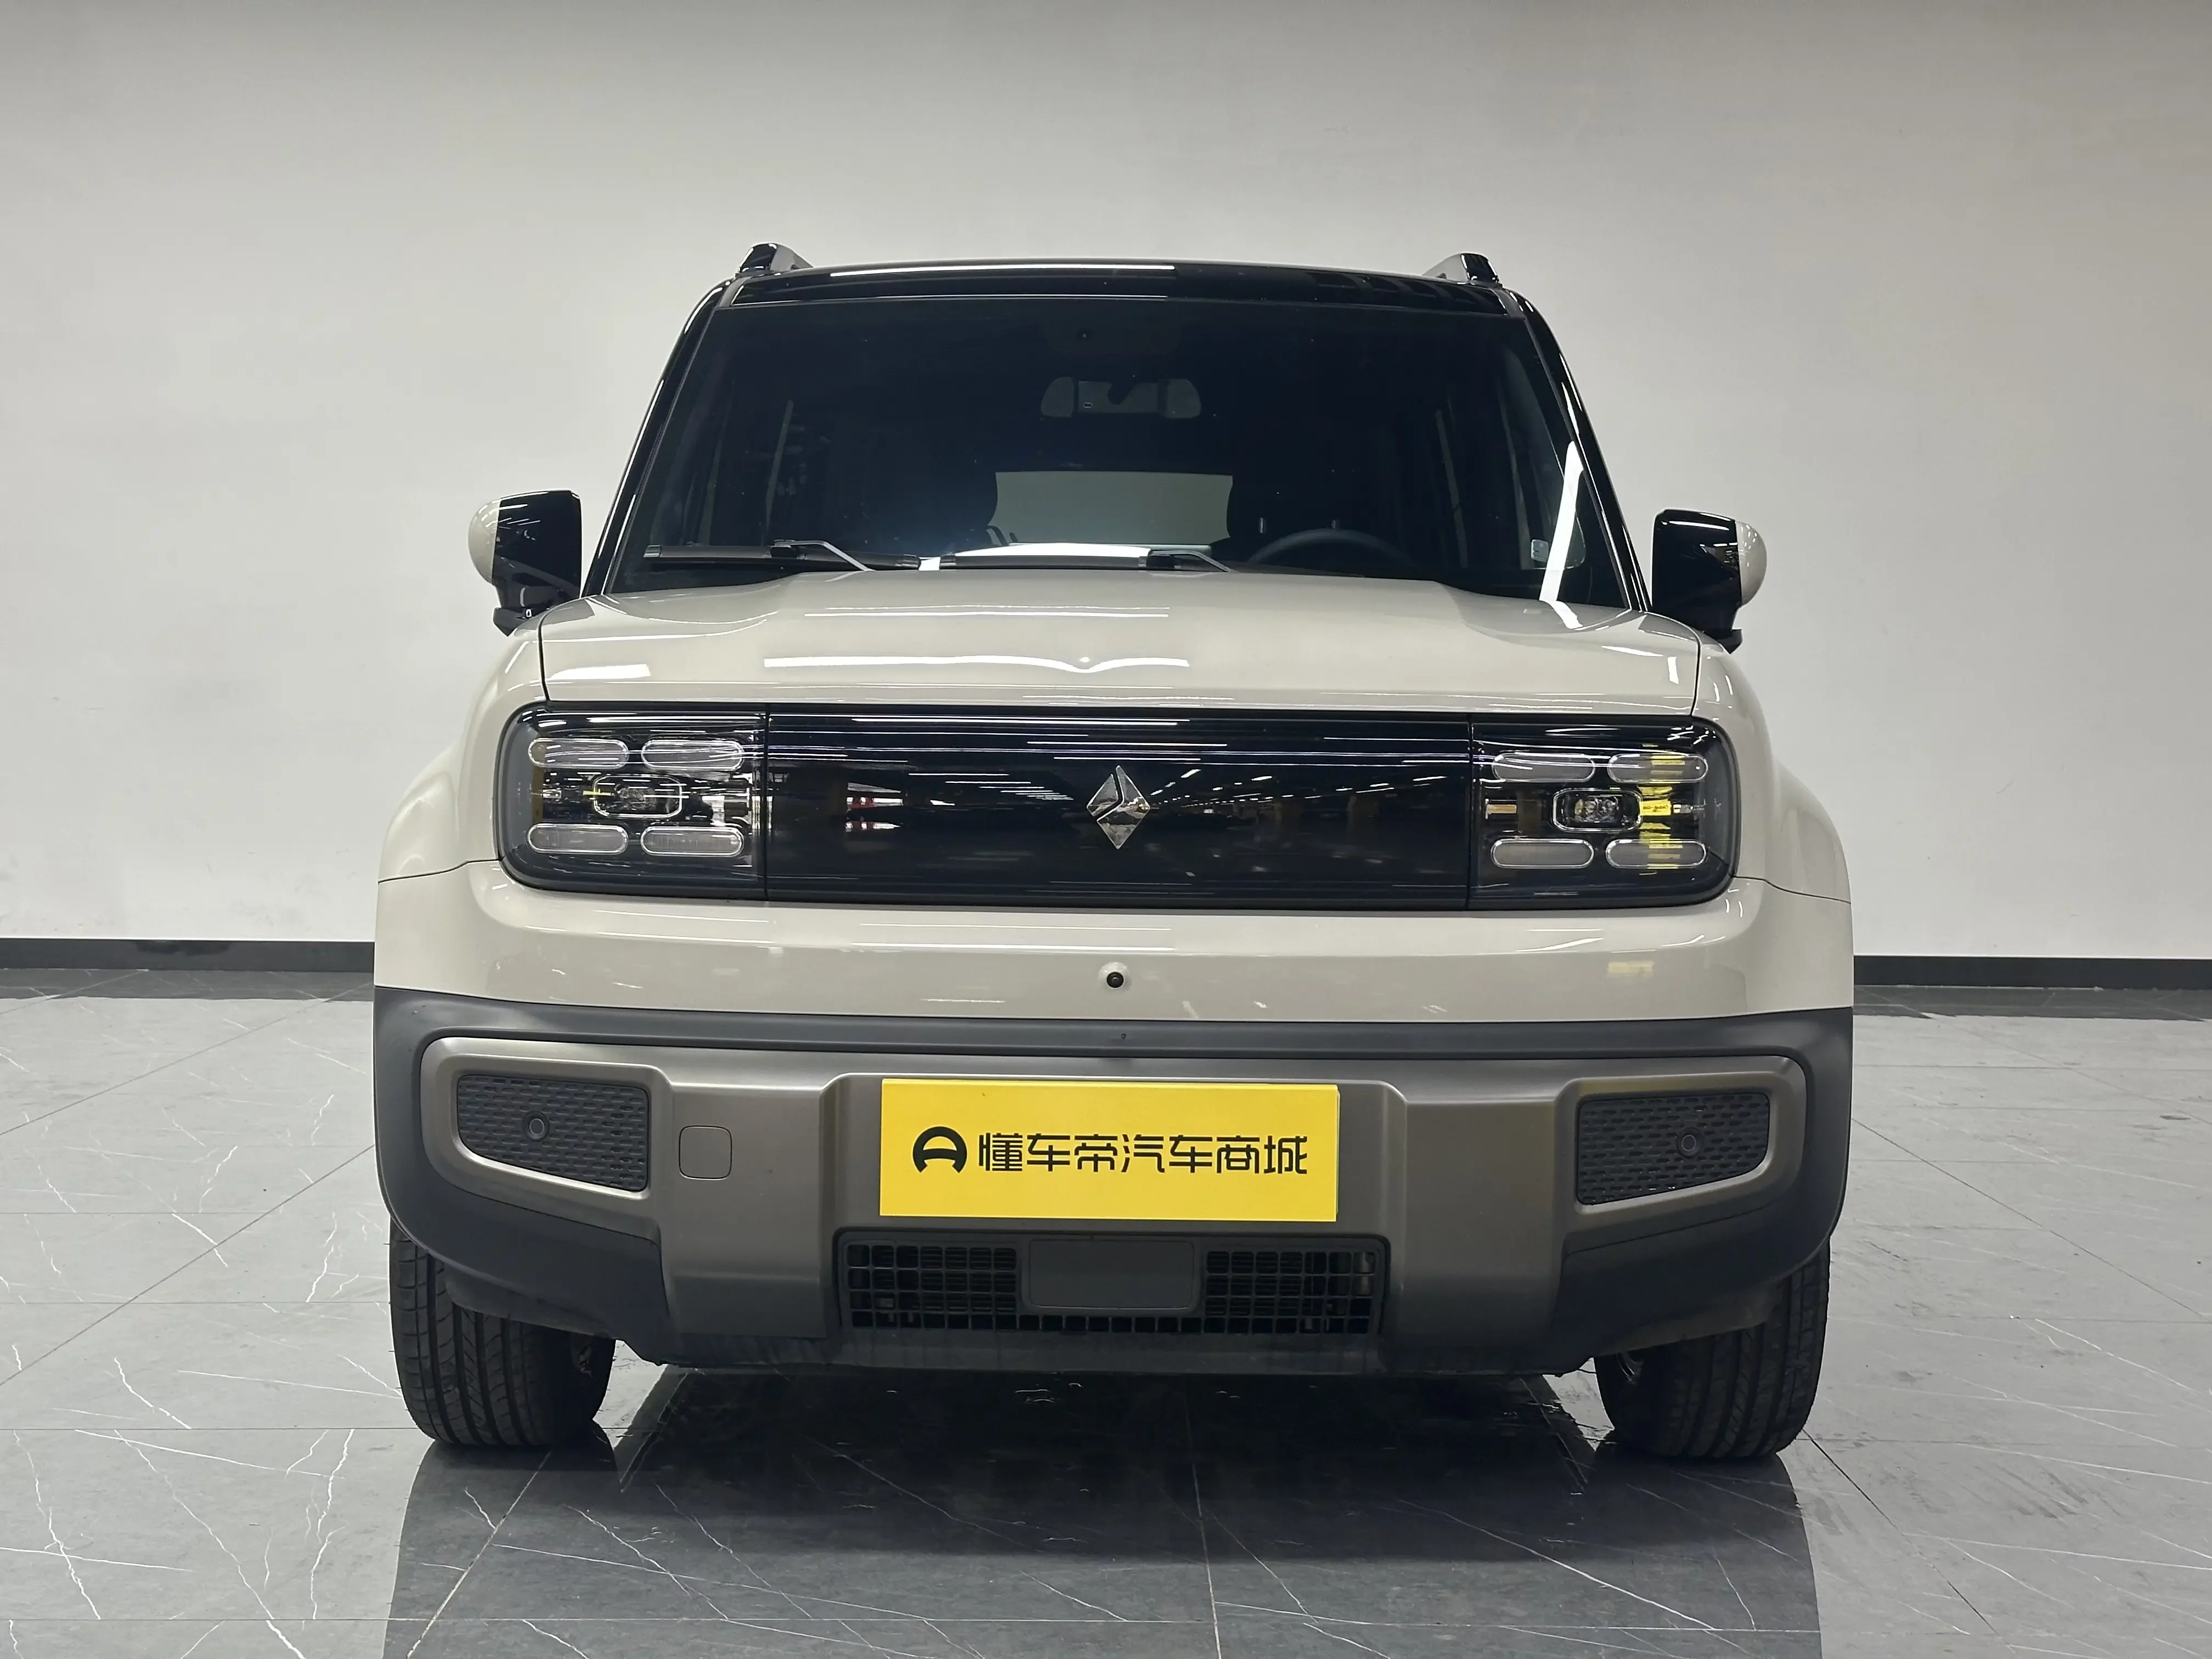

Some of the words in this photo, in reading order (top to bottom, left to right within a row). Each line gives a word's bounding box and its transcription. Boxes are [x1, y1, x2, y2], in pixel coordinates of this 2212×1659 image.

[978, 1132, 1308, 1175] 懂车帝汽车商城
